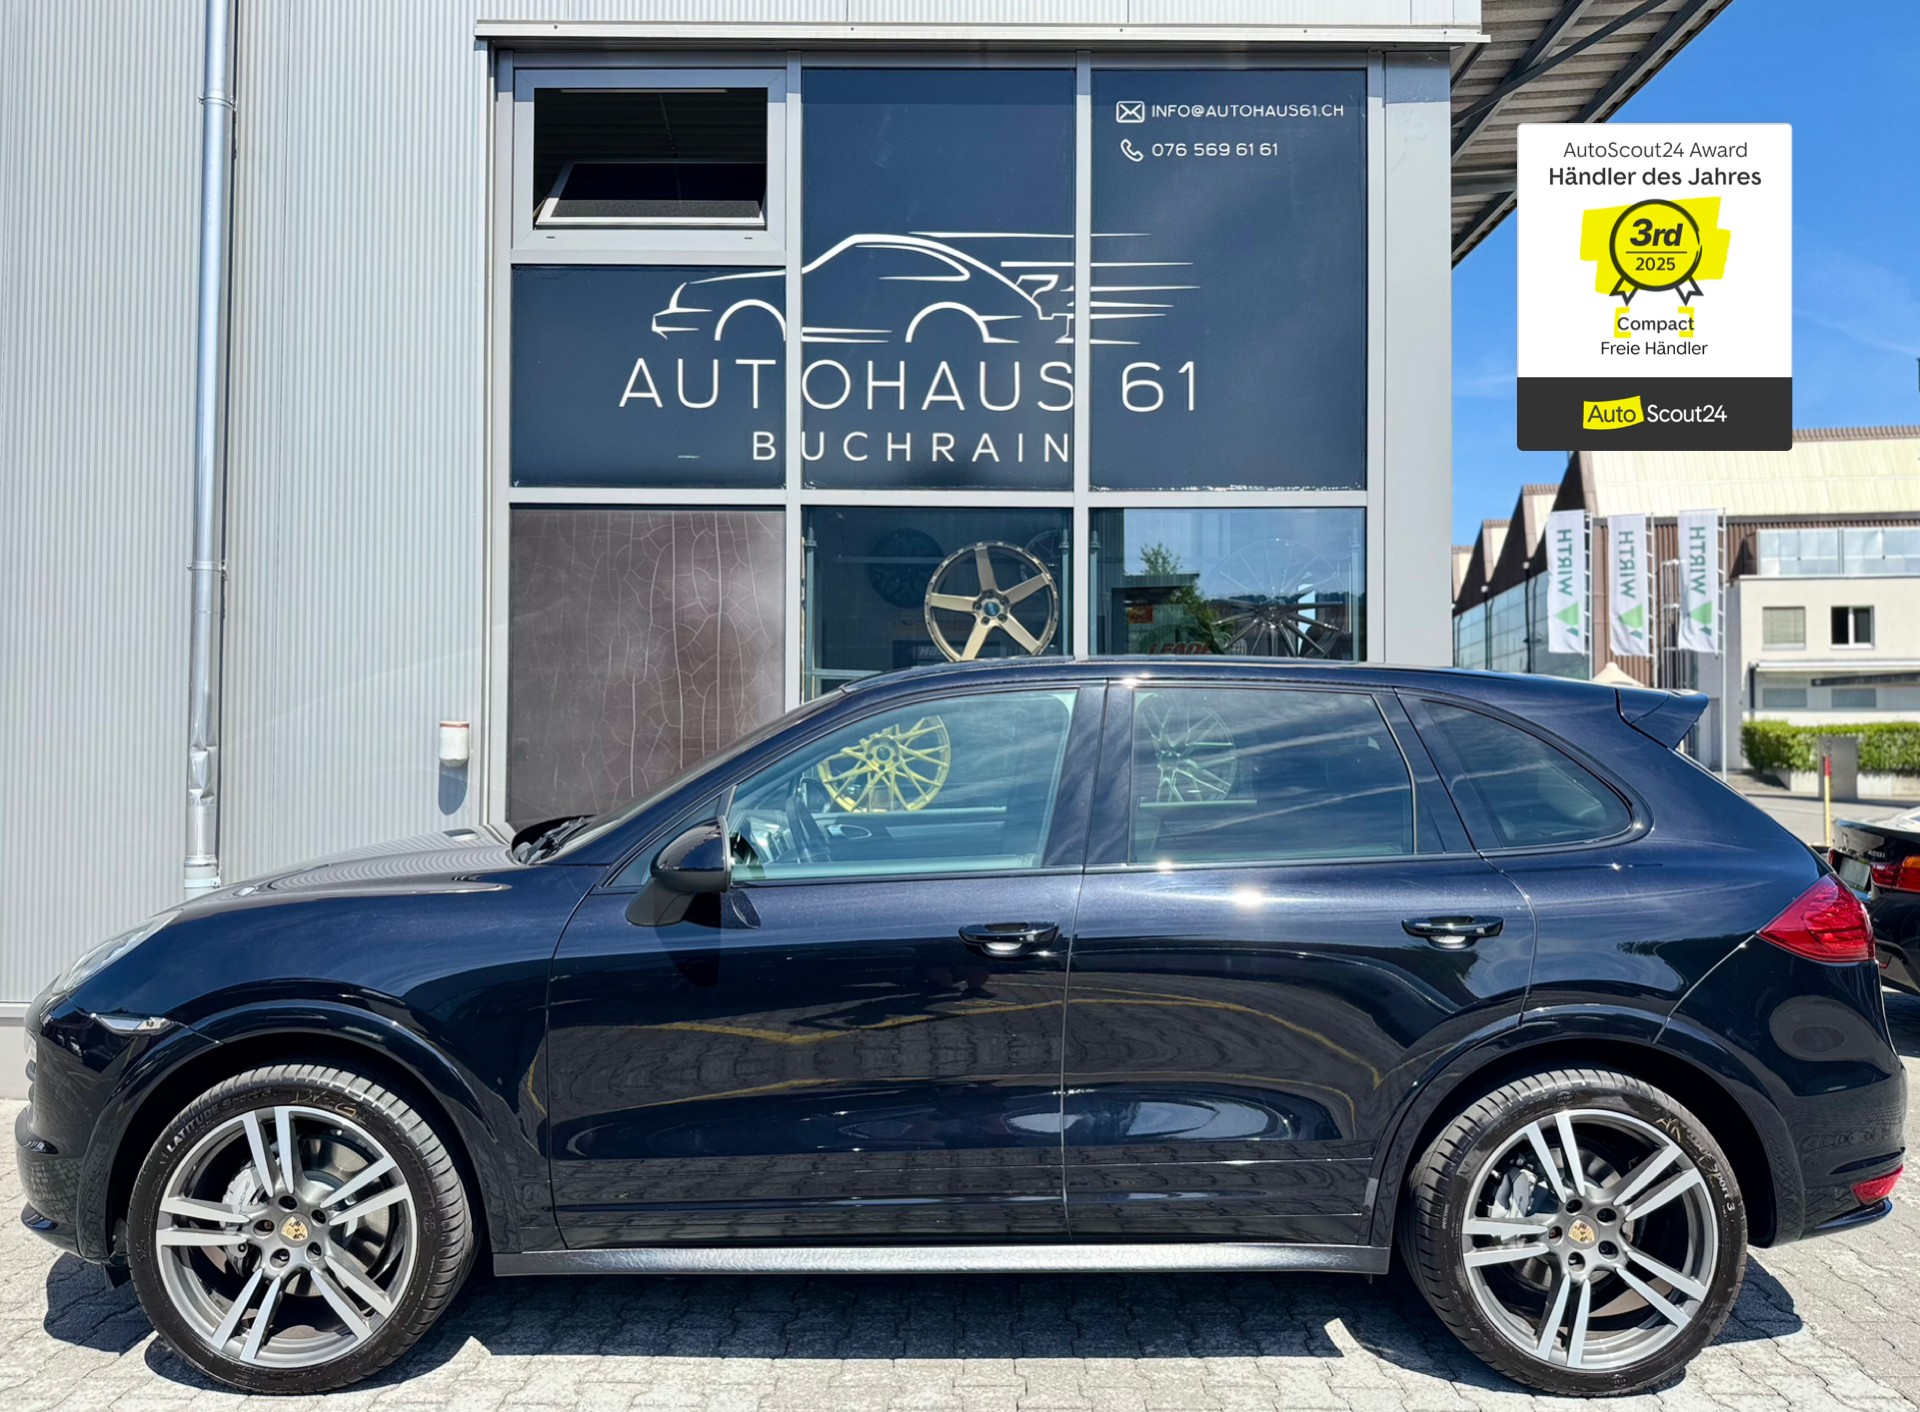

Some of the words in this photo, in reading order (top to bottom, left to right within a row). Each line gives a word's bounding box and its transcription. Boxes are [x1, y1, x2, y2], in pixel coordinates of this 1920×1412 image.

[1151, 104, 1344, 117] INFO@AUTOHAUS61.CH
[1151, 143, 1187, 157] 076
[1193, 143, 1230, 156] 569
[1235, 143, 1254, 156] 61
[1259, 143, 1278, 156] 61
[618, 358, 1074, 411] AUTOHAUS
[1121, 361, 1194, 411] 61
[752, 431, 1069, 462] BUCHRAIN
[166, 1103, 220, 1152] LATITUDE
[1726, 1201, 1735, 1211] 3
